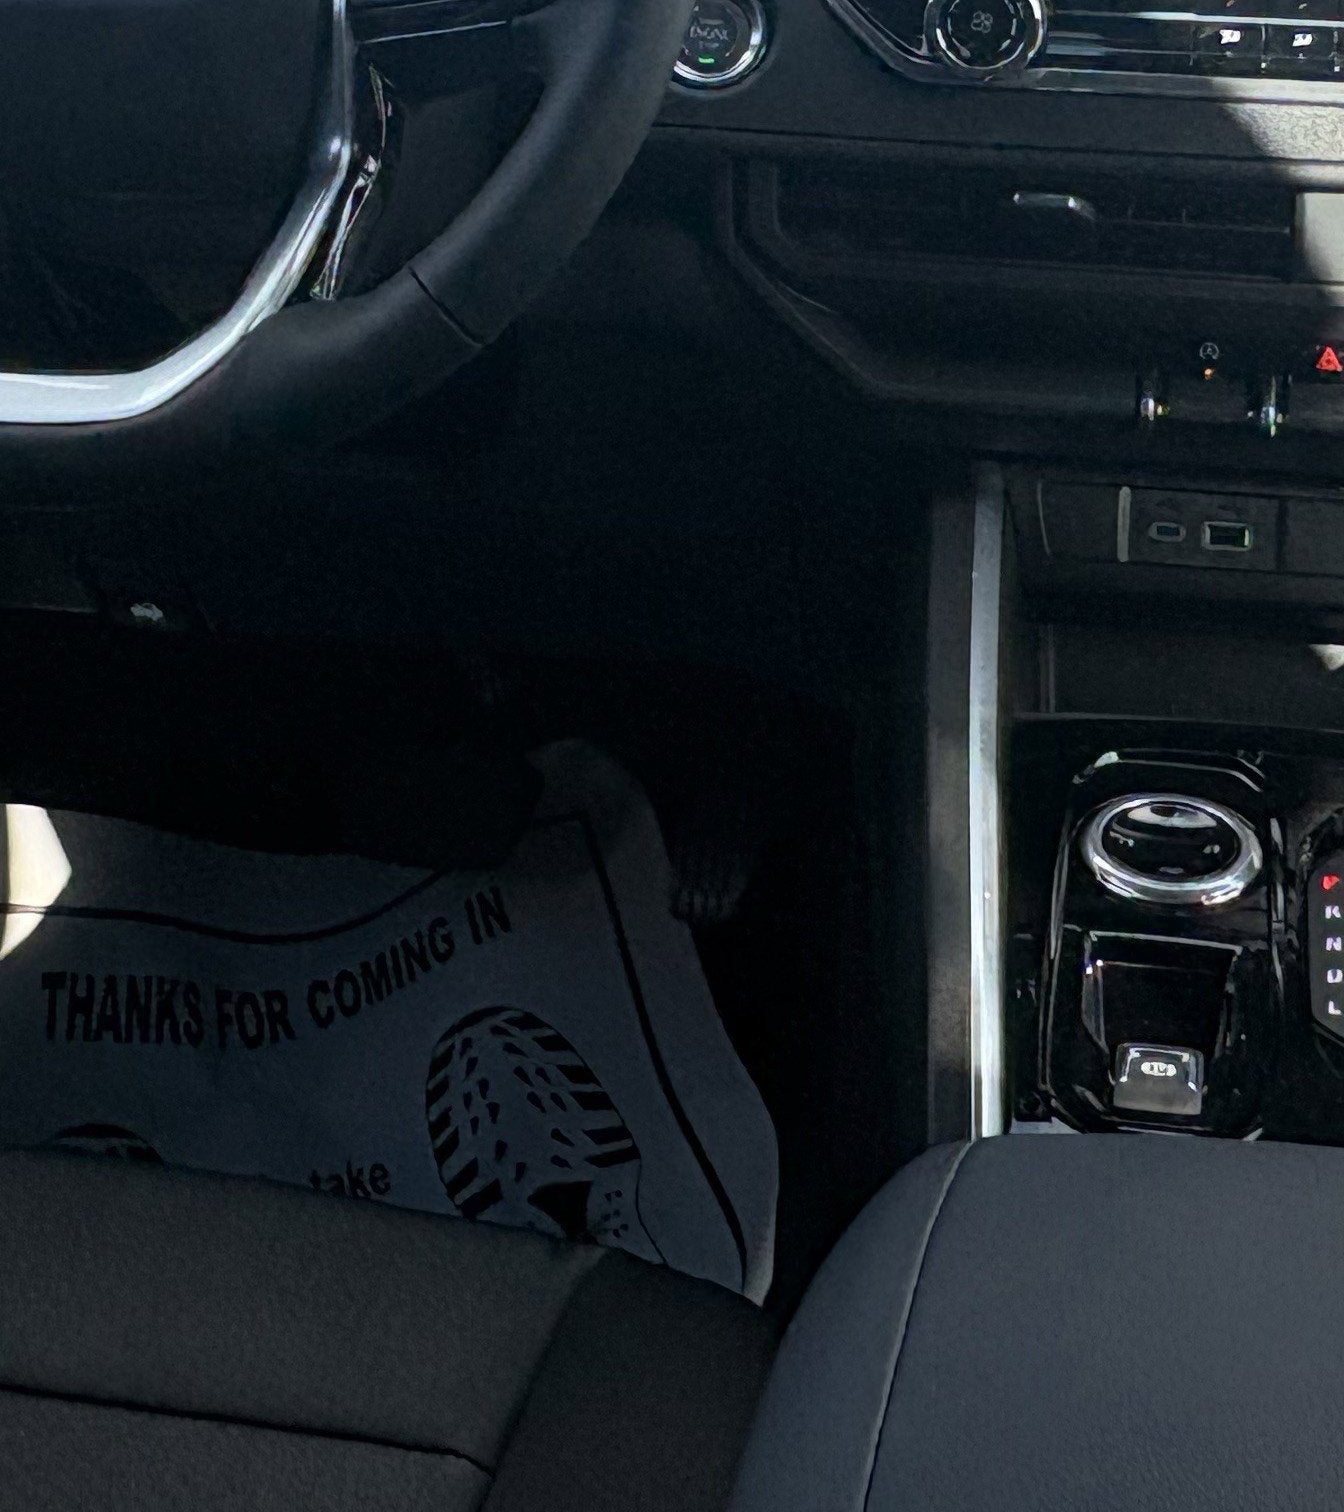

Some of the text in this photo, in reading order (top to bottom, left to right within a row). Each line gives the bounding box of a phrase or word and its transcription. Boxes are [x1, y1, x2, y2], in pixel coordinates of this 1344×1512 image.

[41, 888, 513, 1049] THANKS FOR COMING IN
[309, 1160, 391, 1200] take
